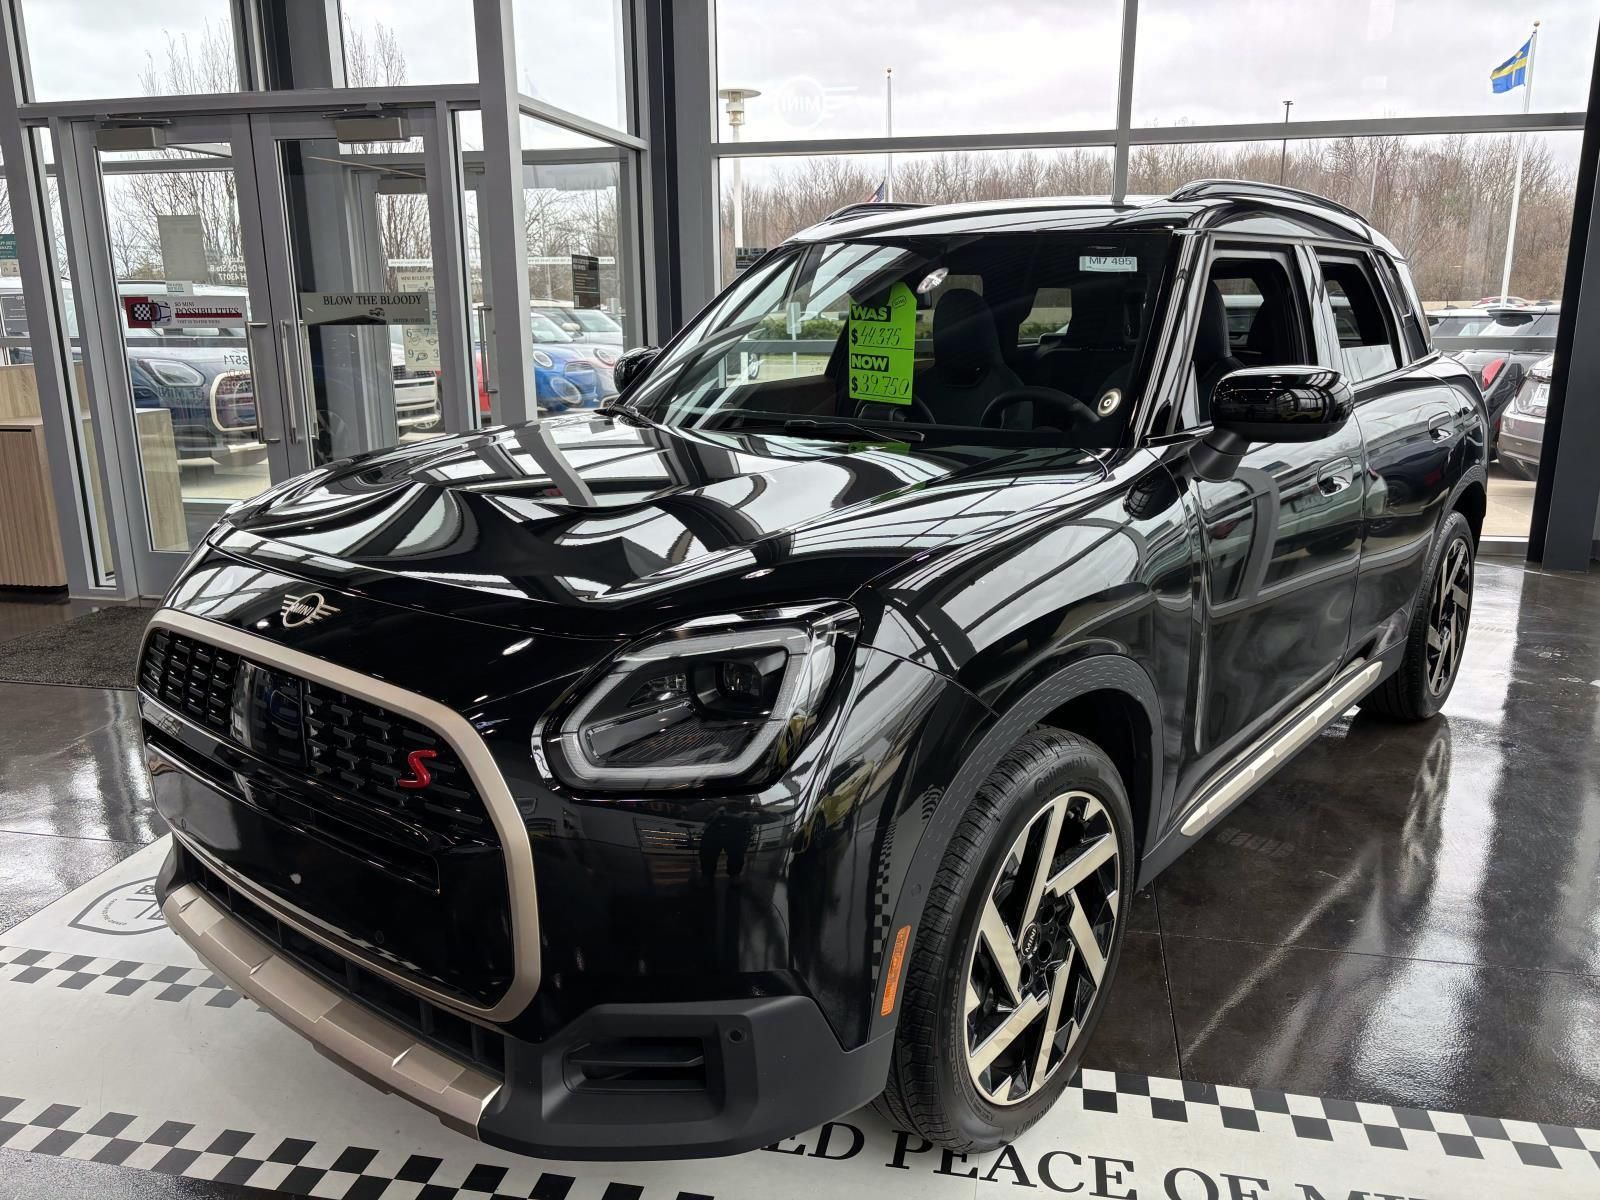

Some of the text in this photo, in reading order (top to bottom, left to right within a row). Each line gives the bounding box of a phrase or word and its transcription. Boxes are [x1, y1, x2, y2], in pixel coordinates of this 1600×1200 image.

[1111, 257, 1132, 265] 495
[323, 295, 422, 305] BLOW THE BLOODY
[852, 305, 888, 320] WAS
[852, 355, 888, 370] NOW
[397, 749, 437, 788] S
[1025, 928, 1037, 953] MINI
[885, 1130, 1138, 1200] PEACE
